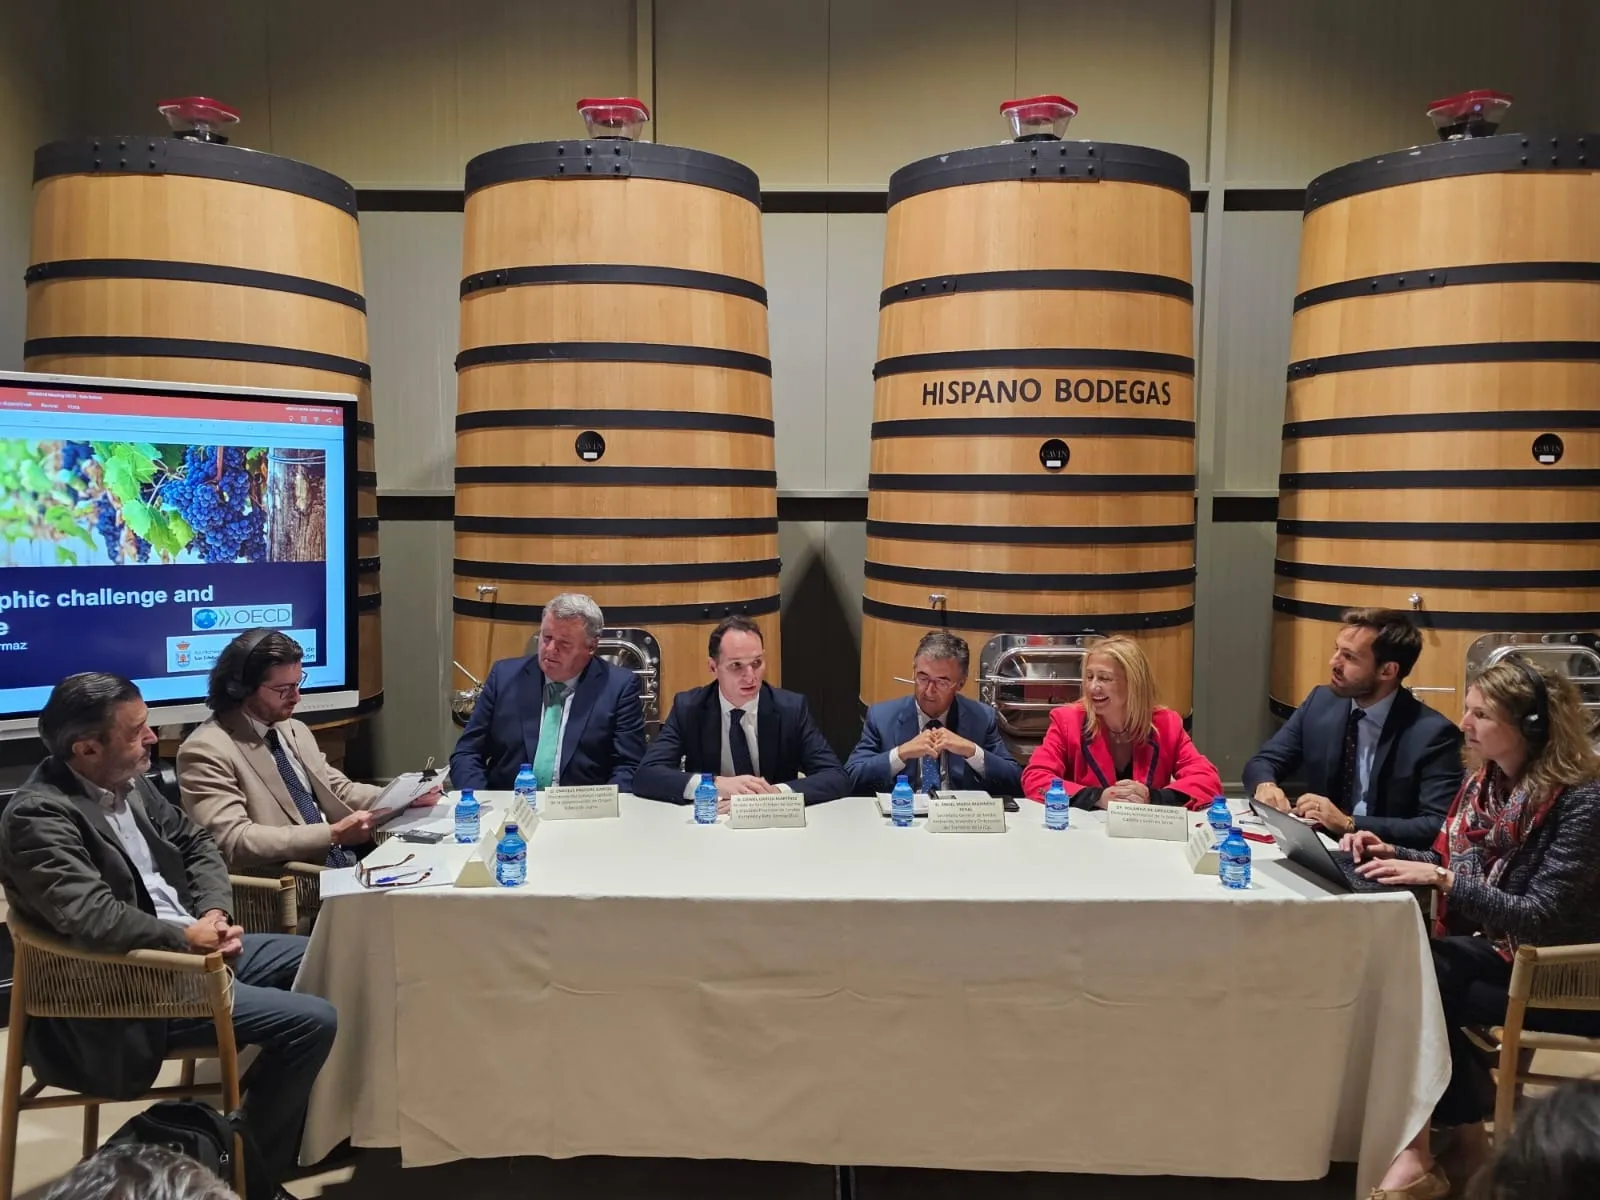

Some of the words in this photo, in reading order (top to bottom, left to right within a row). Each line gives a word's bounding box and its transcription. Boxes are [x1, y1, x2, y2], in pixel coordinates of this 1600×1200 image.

[922, 378, 1042, 406] HISPANO
[1055, 378, 1171, 406] BODEGAS
[57, 588, 168, 608] challenge
[173, 585, 214, 603] and
[234, 608, 291, 624] OECD
